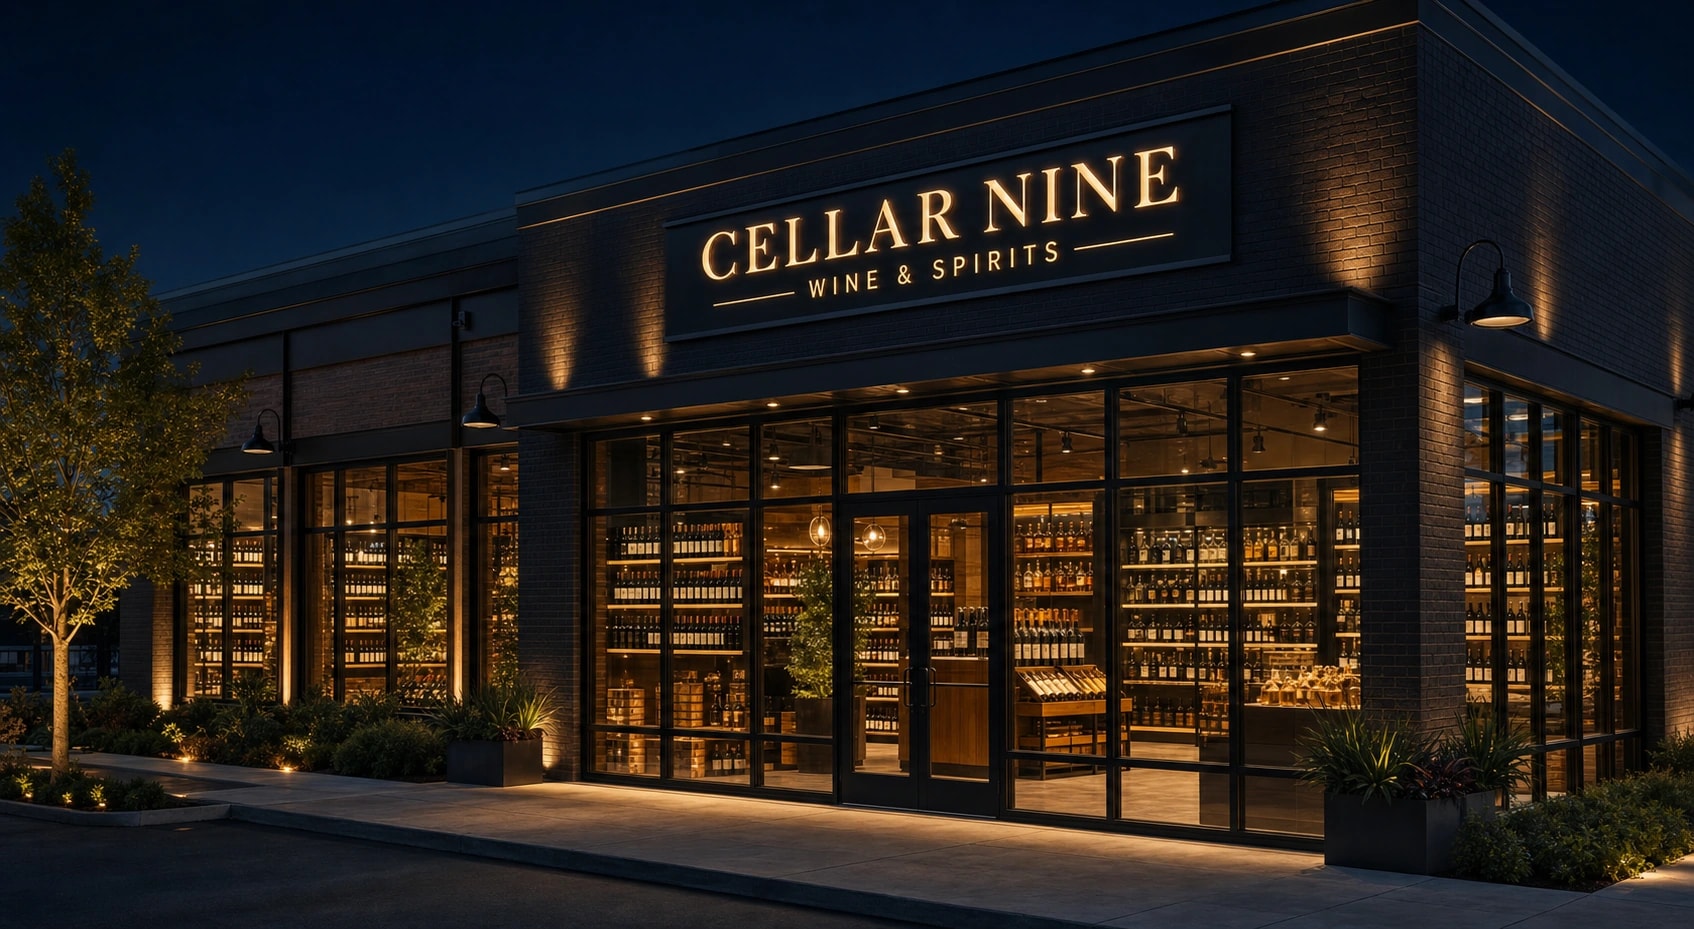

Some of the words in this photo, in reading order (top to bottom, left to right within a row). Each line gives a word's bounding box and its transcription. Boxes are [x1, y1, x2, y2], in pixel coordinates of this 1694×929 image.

[701, 189, 960, 281] CELLAR
[983, 145, 1180, 233] NINE
[808, 269, 879, 299] WINE
[897, 264, 912, 285] &
[932, 241, 1059, 280] SPIRITS
